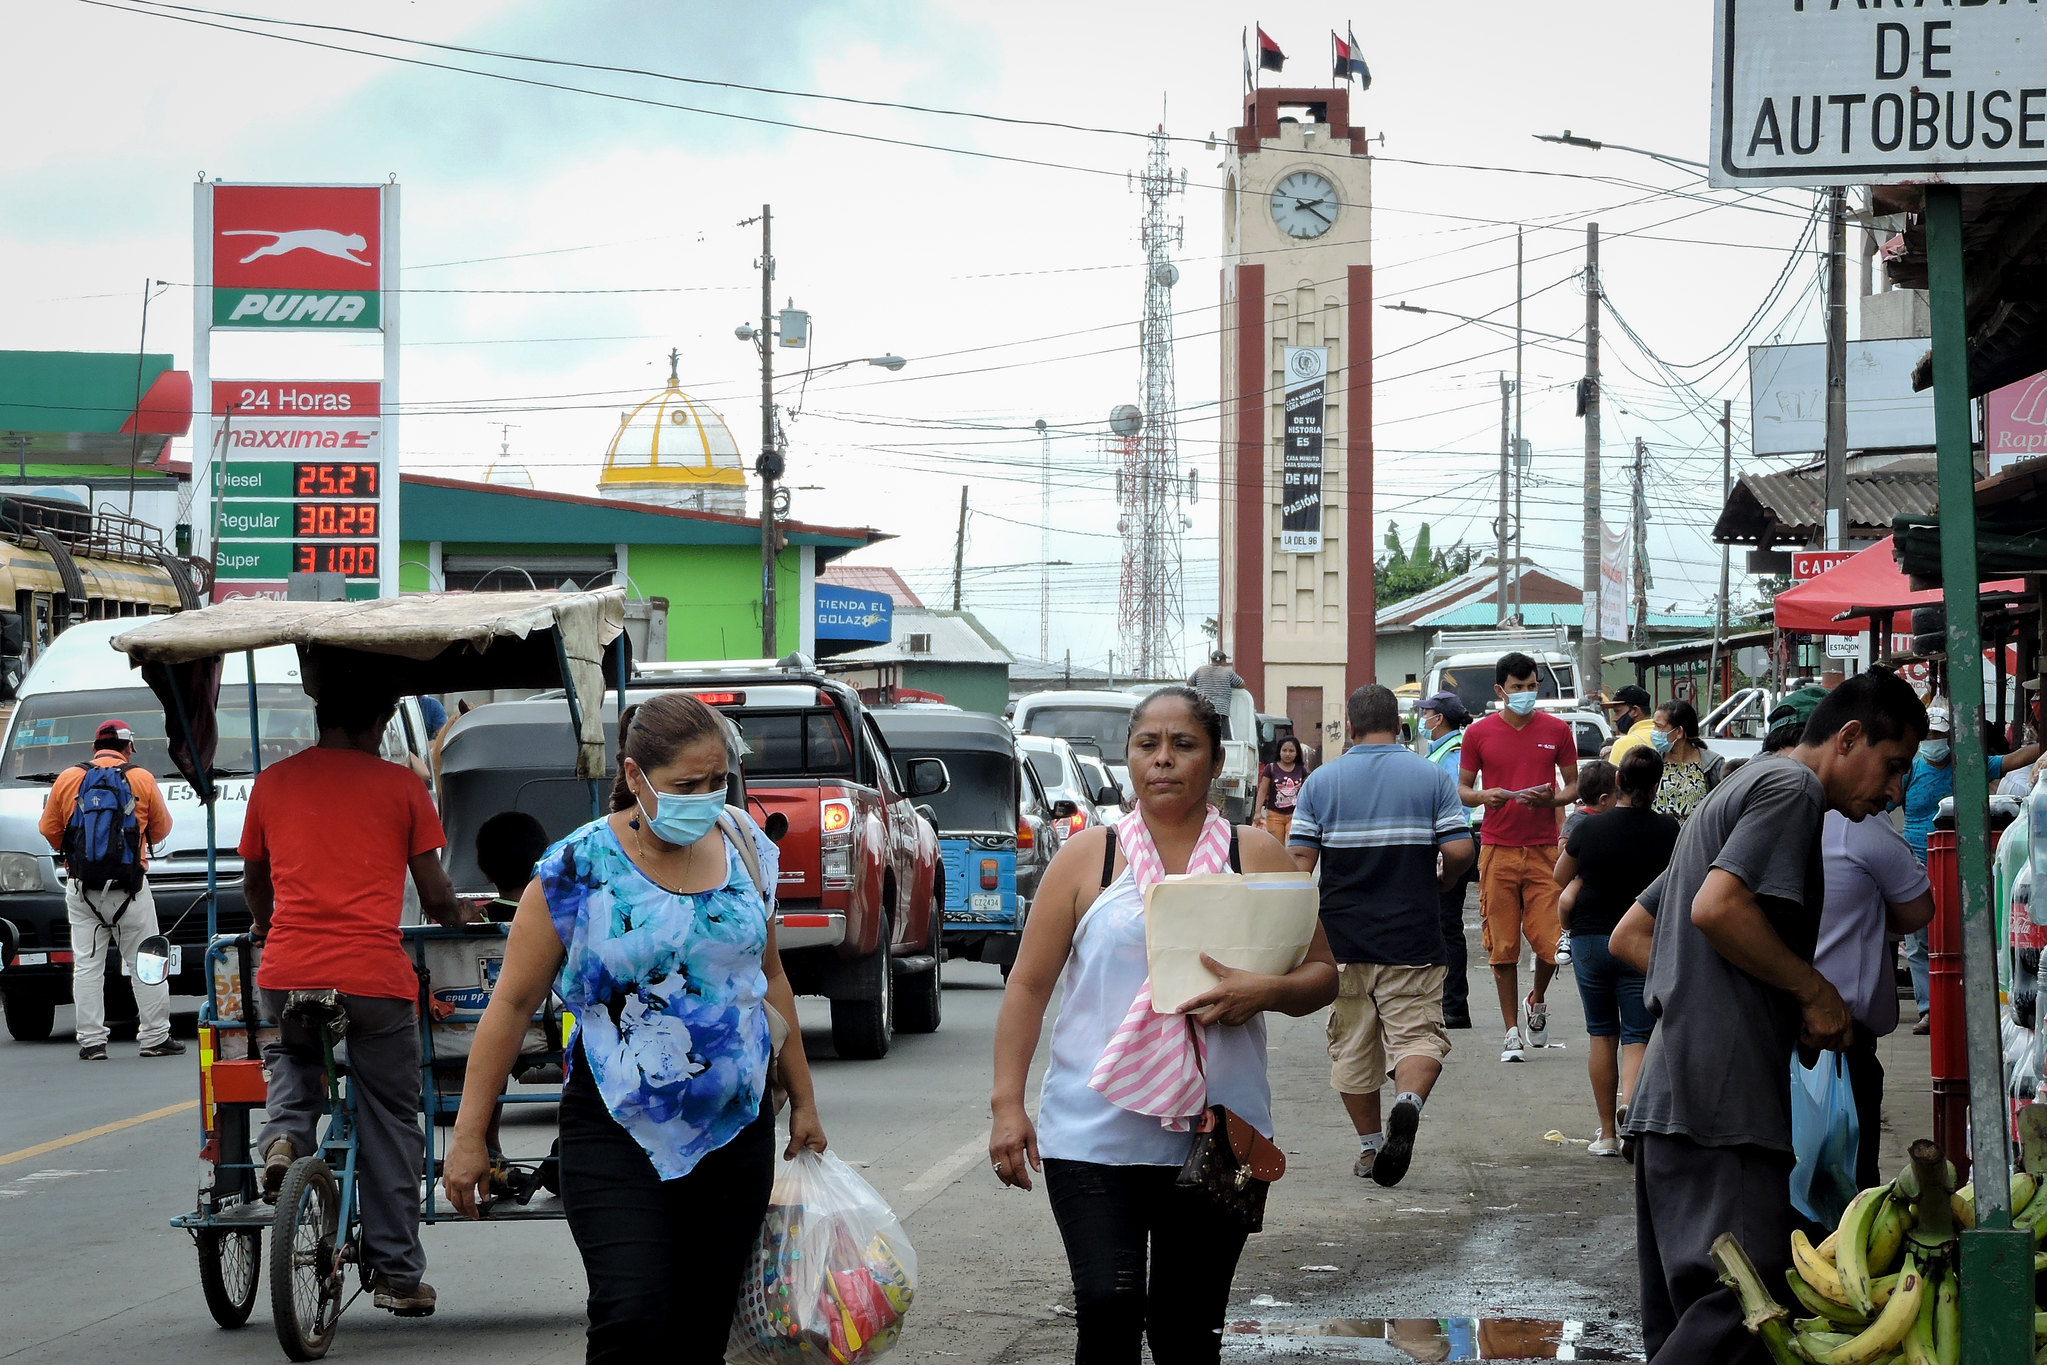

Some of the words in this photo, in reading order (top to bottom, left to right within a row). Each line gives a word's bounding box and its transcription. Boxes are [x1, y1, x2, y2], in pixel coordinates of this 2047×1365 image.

[1875, 21, 1952, 80] DE
[1746, 88, 2047, 157] AUTOBUSE
[228, 294, 366, 322] PUMA
[240, 389, 270, 410] 24
[279, 389, 352, 411] Horas
[1288, 426, 1322, 434] HISTORIA
[1293, 416, 1304, 424] DE
[1304, 416, 1316, 424] TU
[213, 429, 339, 449] maxxima
[1296, 437, 1310, 447] ES
[215, 472, 262, 487] Diesel
[300, 466, 376, 494] 25.27
[1285, 473, 1300, 485] DE
[1303, 473, 1318, 485] MI
[1283, 493, 1319, 516] PASIÓN
[219, 512, 280, 531] Regular
[300, 506, 376, 534] 30.29
[1284, 535, 1292, 545] LA
[1293, 536, 1307, 545] DEL
[1308, 536, 1318, 545] 96
[216, 552, 260, 569] Super
[300, 546, 375, 574] 31.00
[818, 599, 866, 611] TIENDA
[871, 602, 886, 612] EL
